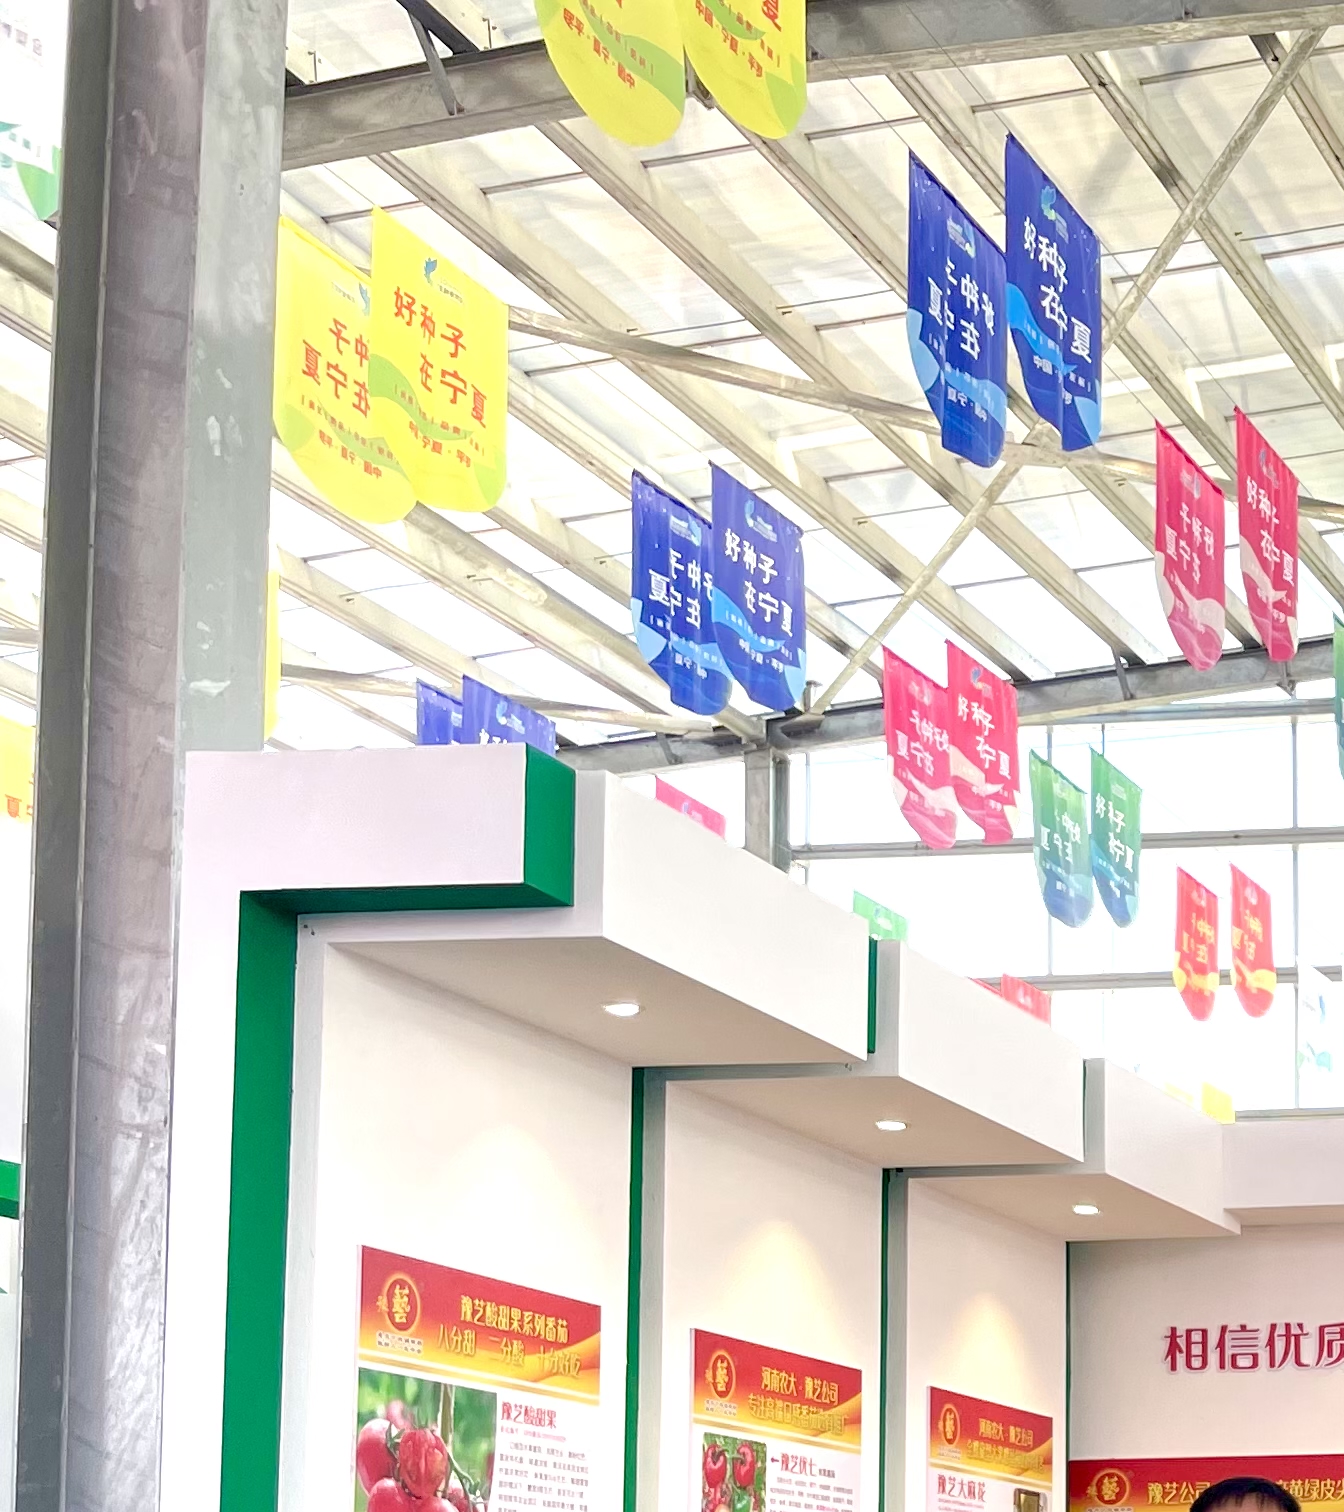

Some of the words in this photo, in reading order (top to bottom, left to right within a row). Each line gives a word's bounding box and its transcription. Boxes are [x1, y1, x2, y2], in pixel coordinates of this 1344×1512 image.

[394, 286, 466, 358] 好种子
[420, 352, 487, 428] 在宁夏
[724, 529, 778, 584] 好种子
[744, 582, 793, 638] 在宁夏
[957, 693, 995, 739] 好种子
[438, 1324, 476, 1355] 八分甜
[489, 1336, 525, 1366] 二分酸
[537, 1346, 581, 1378] 十分好吃
